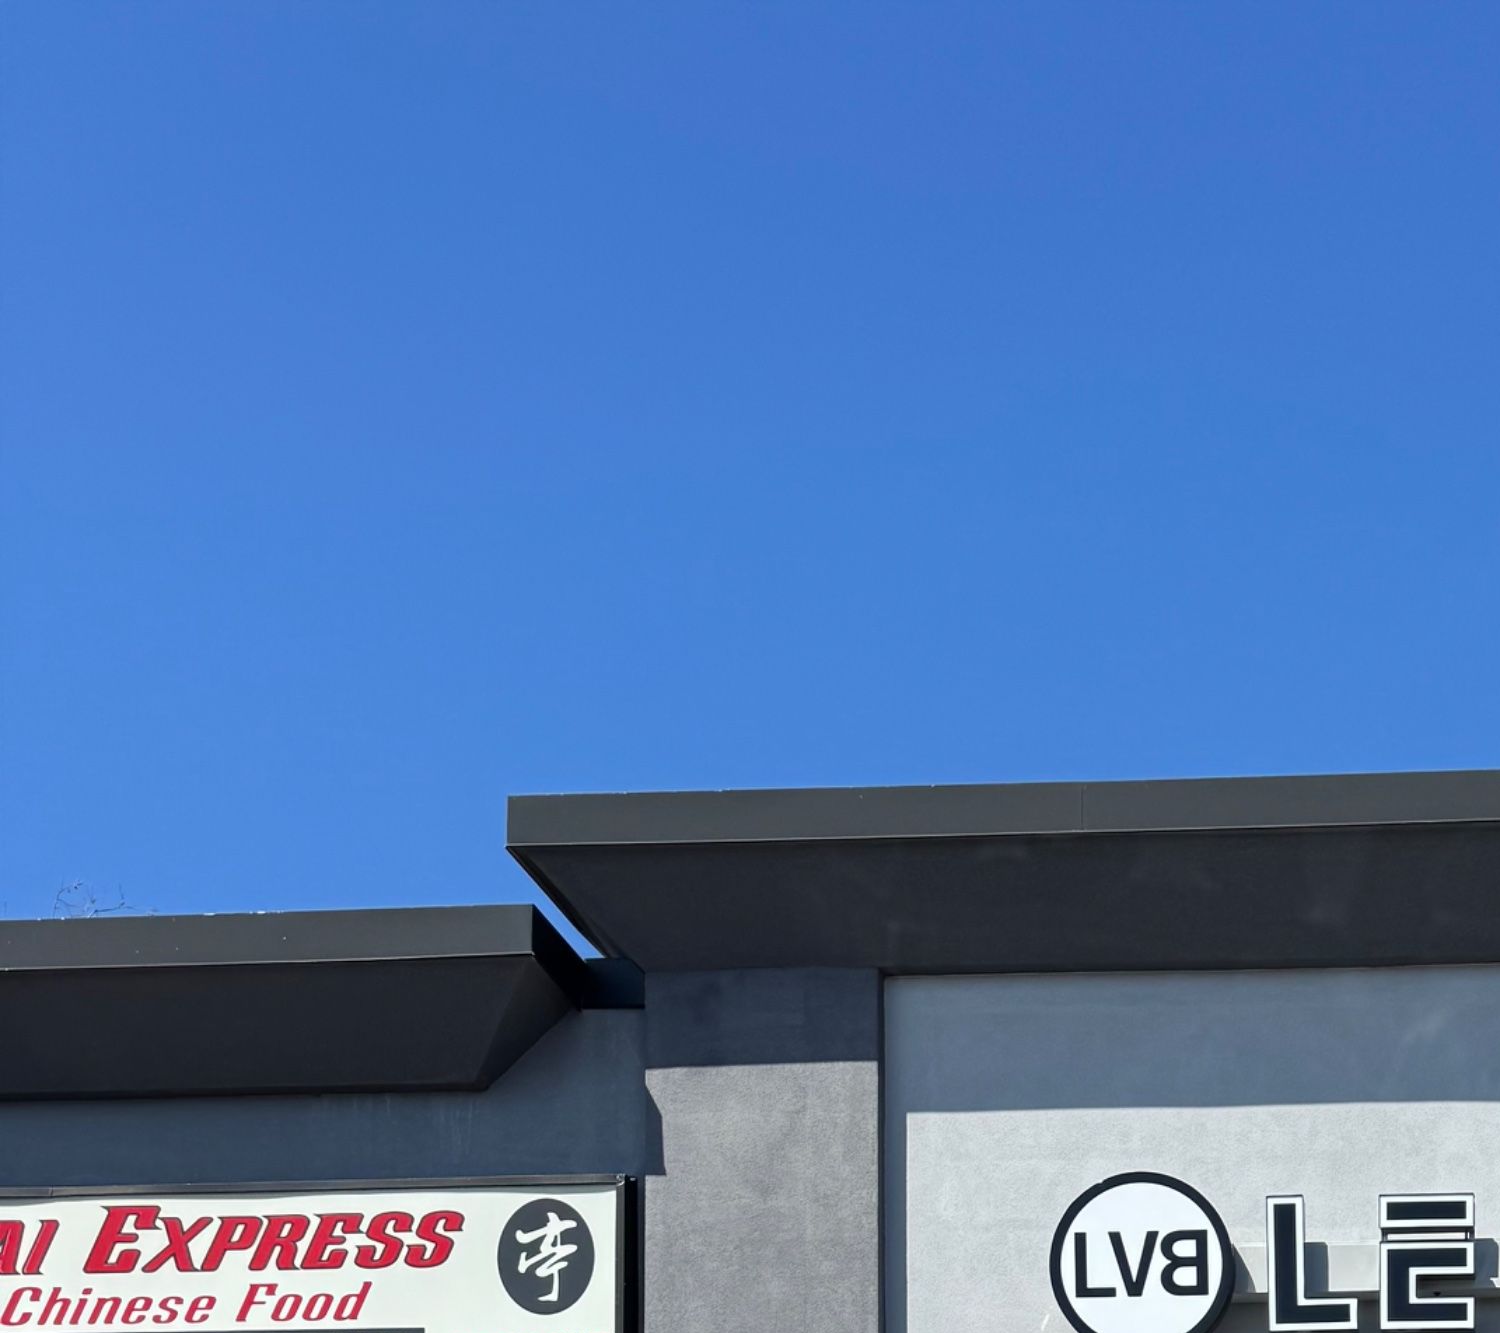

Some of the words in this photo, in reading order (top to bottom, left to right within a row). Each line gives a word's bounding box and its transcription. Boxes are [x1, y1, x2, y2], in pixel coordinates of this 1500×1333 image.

[82, 1204, 465, 1275] EXPRESS
[0, 1285, 216, 1327] Chinese
[236, 1280, 373, 1324] Food
